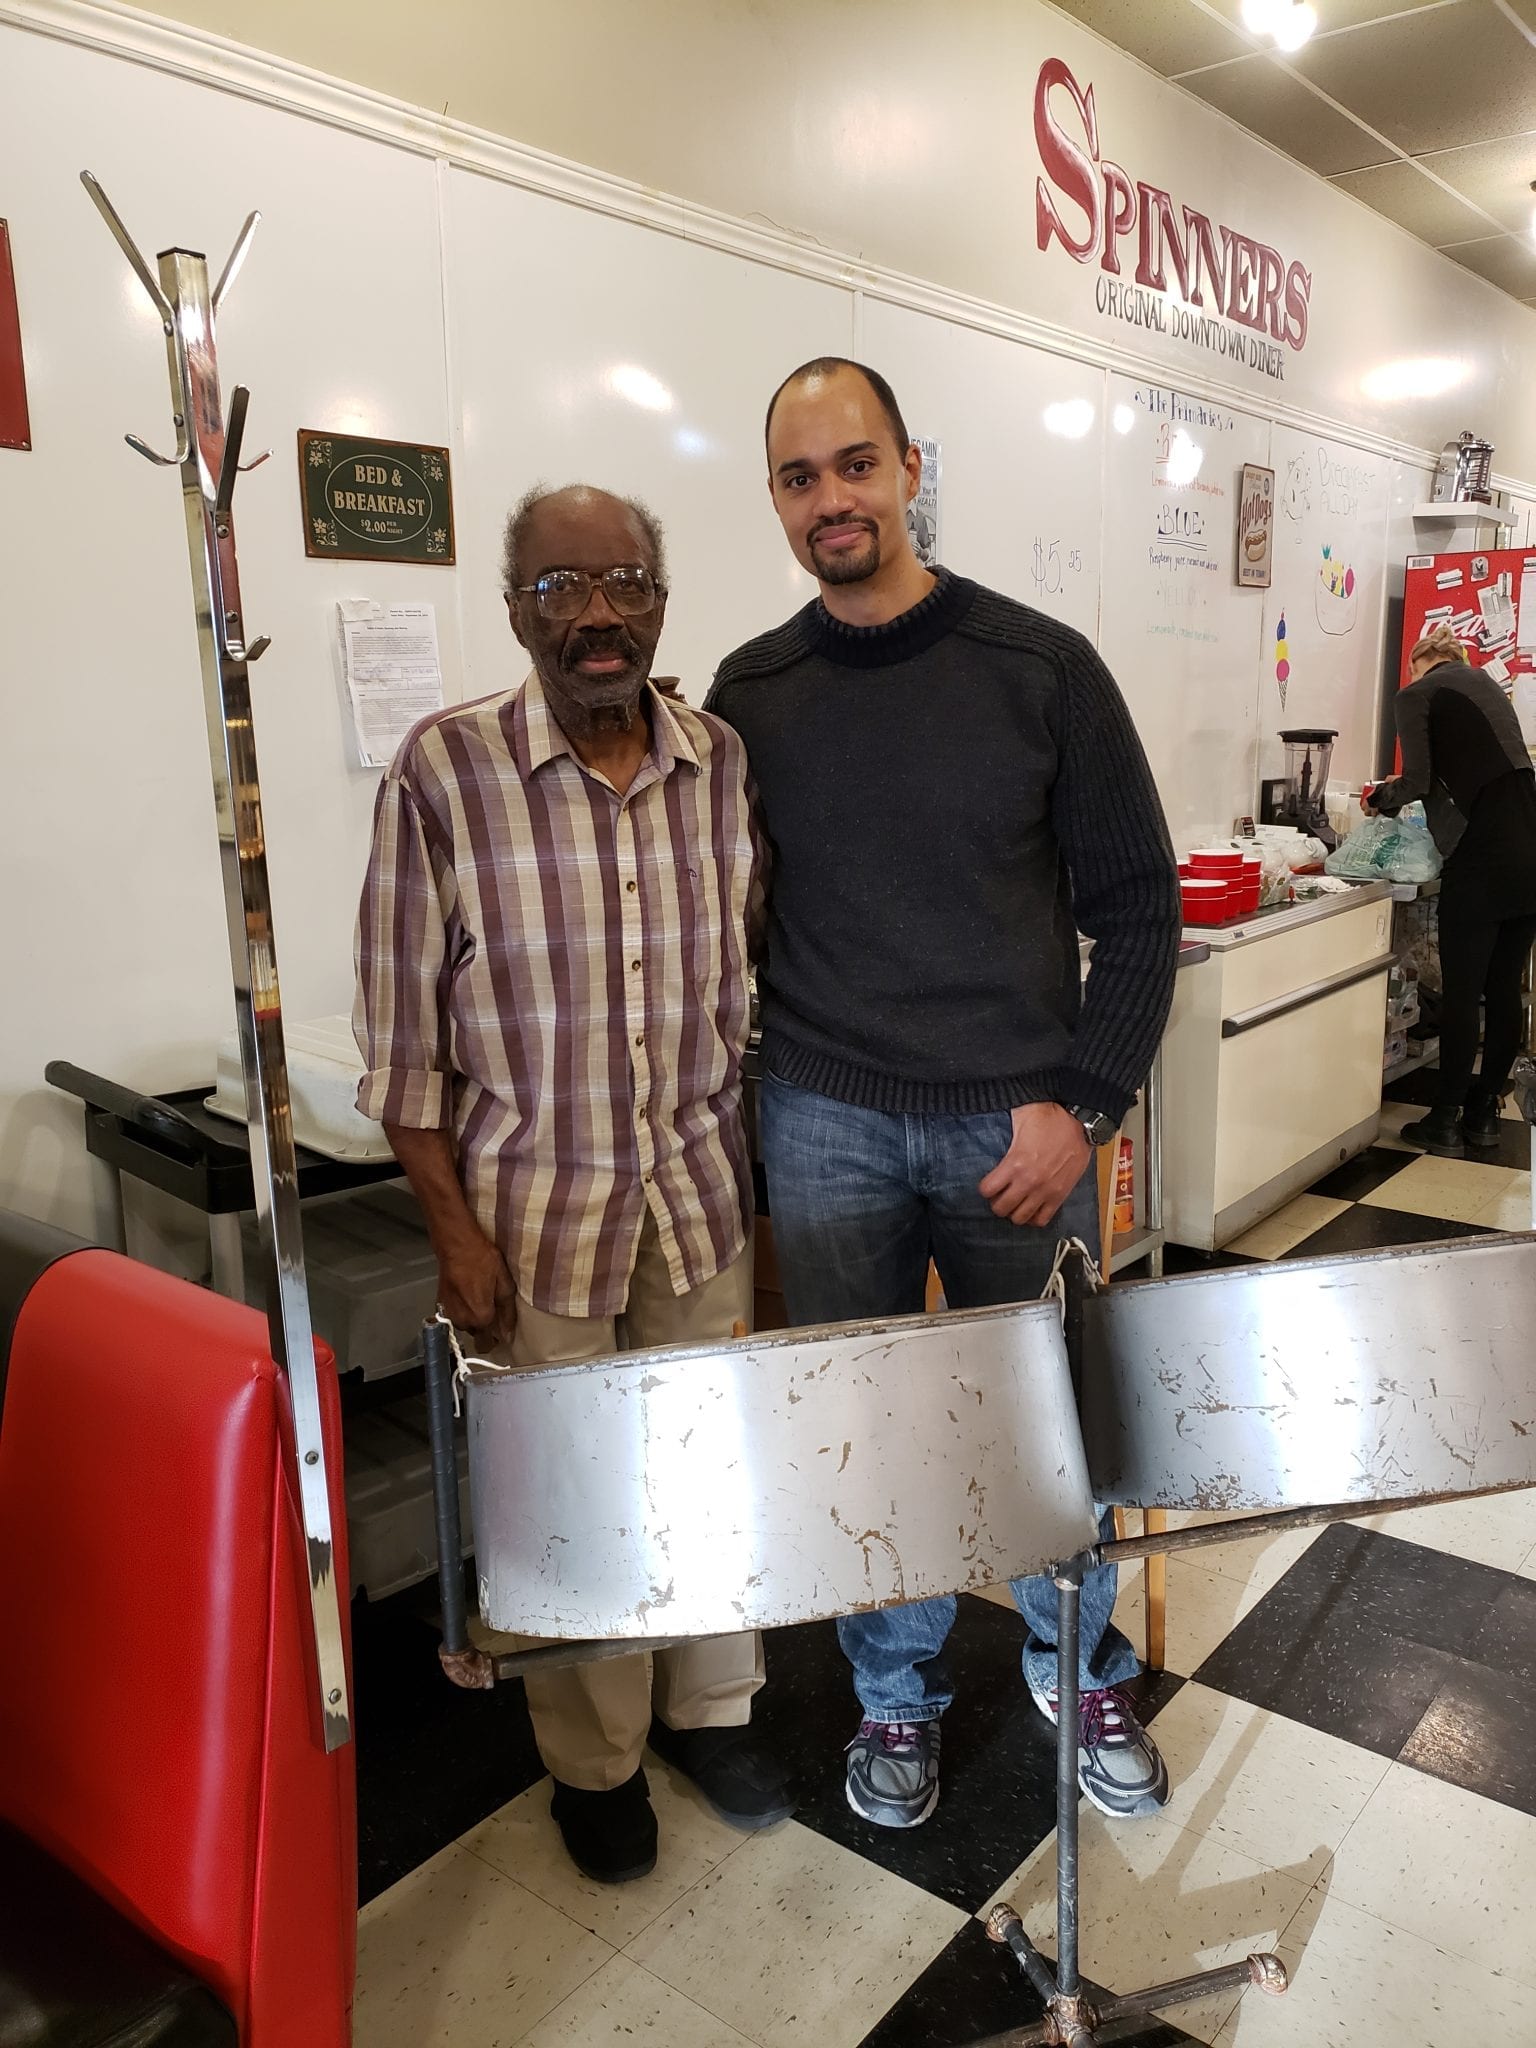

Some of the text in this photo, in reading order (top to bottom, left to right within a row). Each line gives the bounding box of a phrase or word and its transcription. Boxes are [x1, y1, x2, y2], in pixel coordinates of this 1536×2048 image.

[1034, 57, 1312, 351] SPINNERS
[1095, 275, 1284, 381] ORIGINAL DOWNTOWN DINER
[1146, 388, 1167, 414] The
[354, 464, 403, 487] BED &
[333, 490, 426, 517] BREAKFAST
[360, 519, 387, 534] $2.00
[1158, 503, 1202, 537] BLUE
